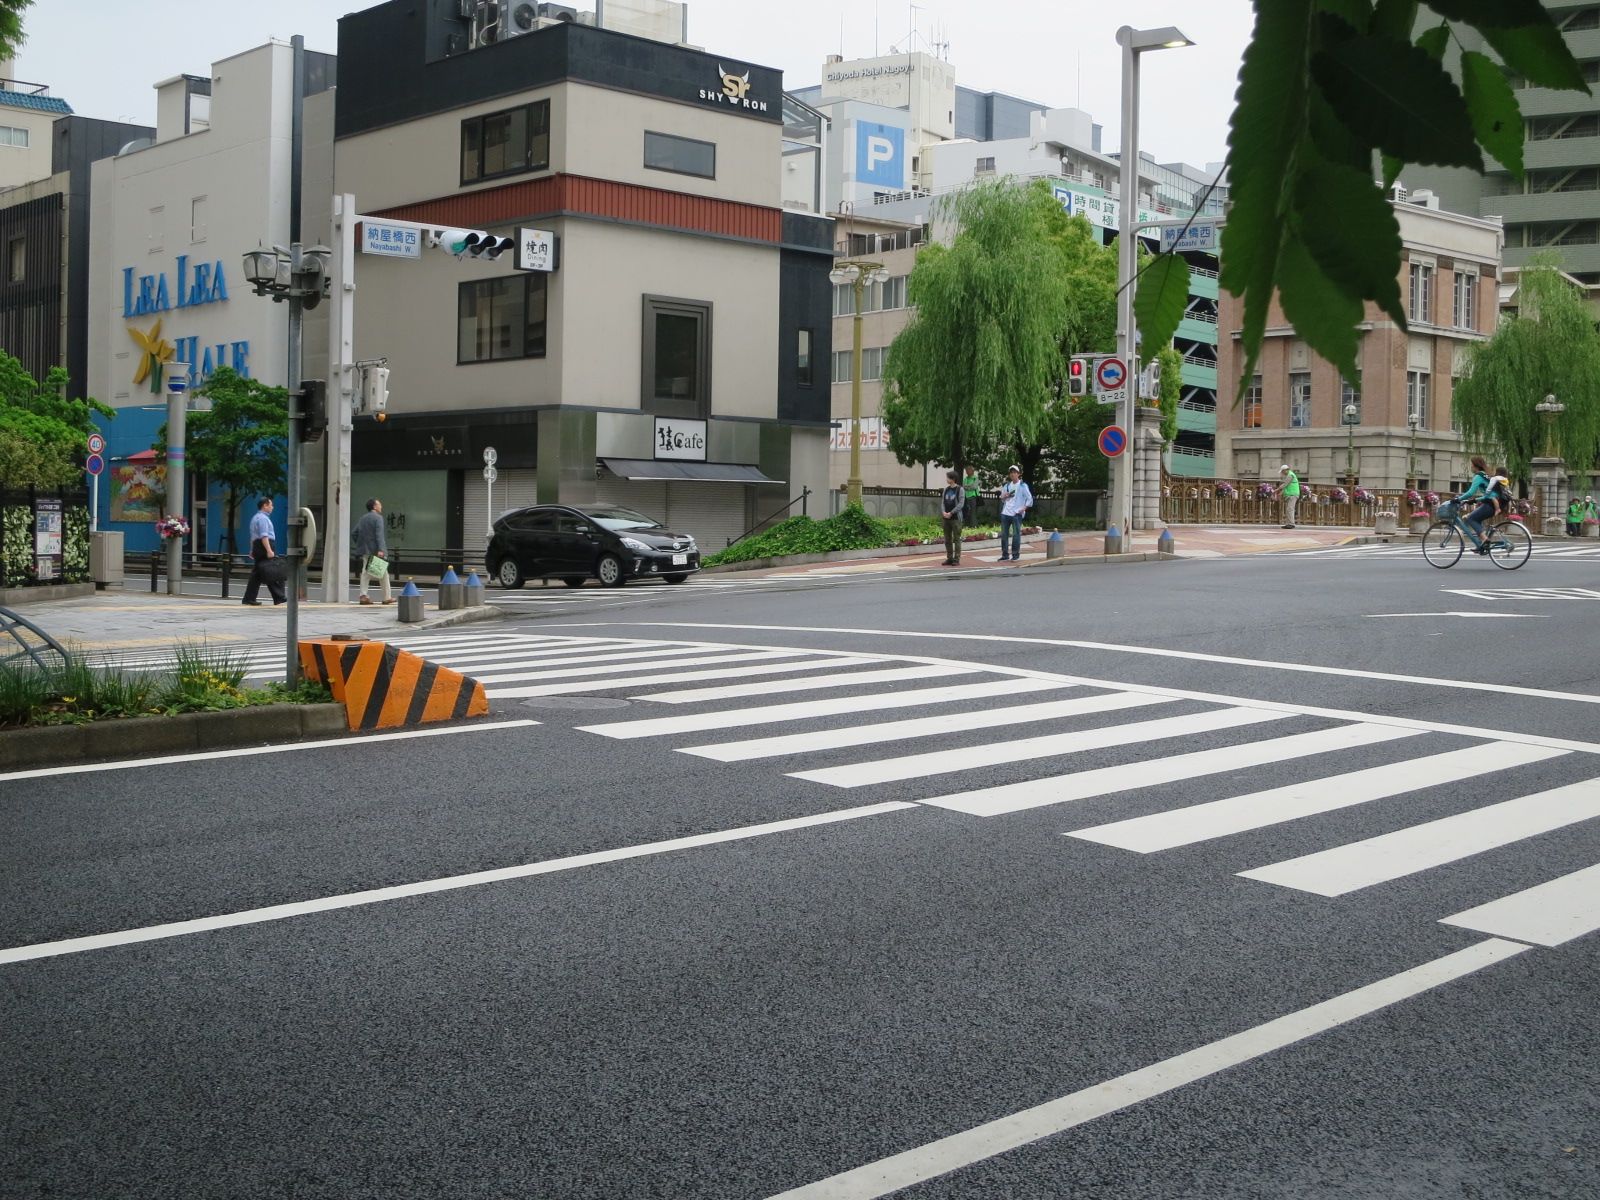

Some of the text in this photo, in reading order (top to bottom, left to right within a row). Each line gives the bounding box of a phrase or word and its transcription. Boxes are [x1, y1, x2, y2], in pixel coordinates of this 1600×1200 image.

[826, 64, 915, 82] Chiyoda Hotel Nagoya
[699, 89, 767, 111] SHY RON
[867, 135, 894, 171] P
[1074, 194, 1115, 214] 時間貸
[367, 226, 416, 245] 納屋橋西
[370, 241, 402, 252] Nayabashi
[1100, 391, 1126, 402] 8-22
